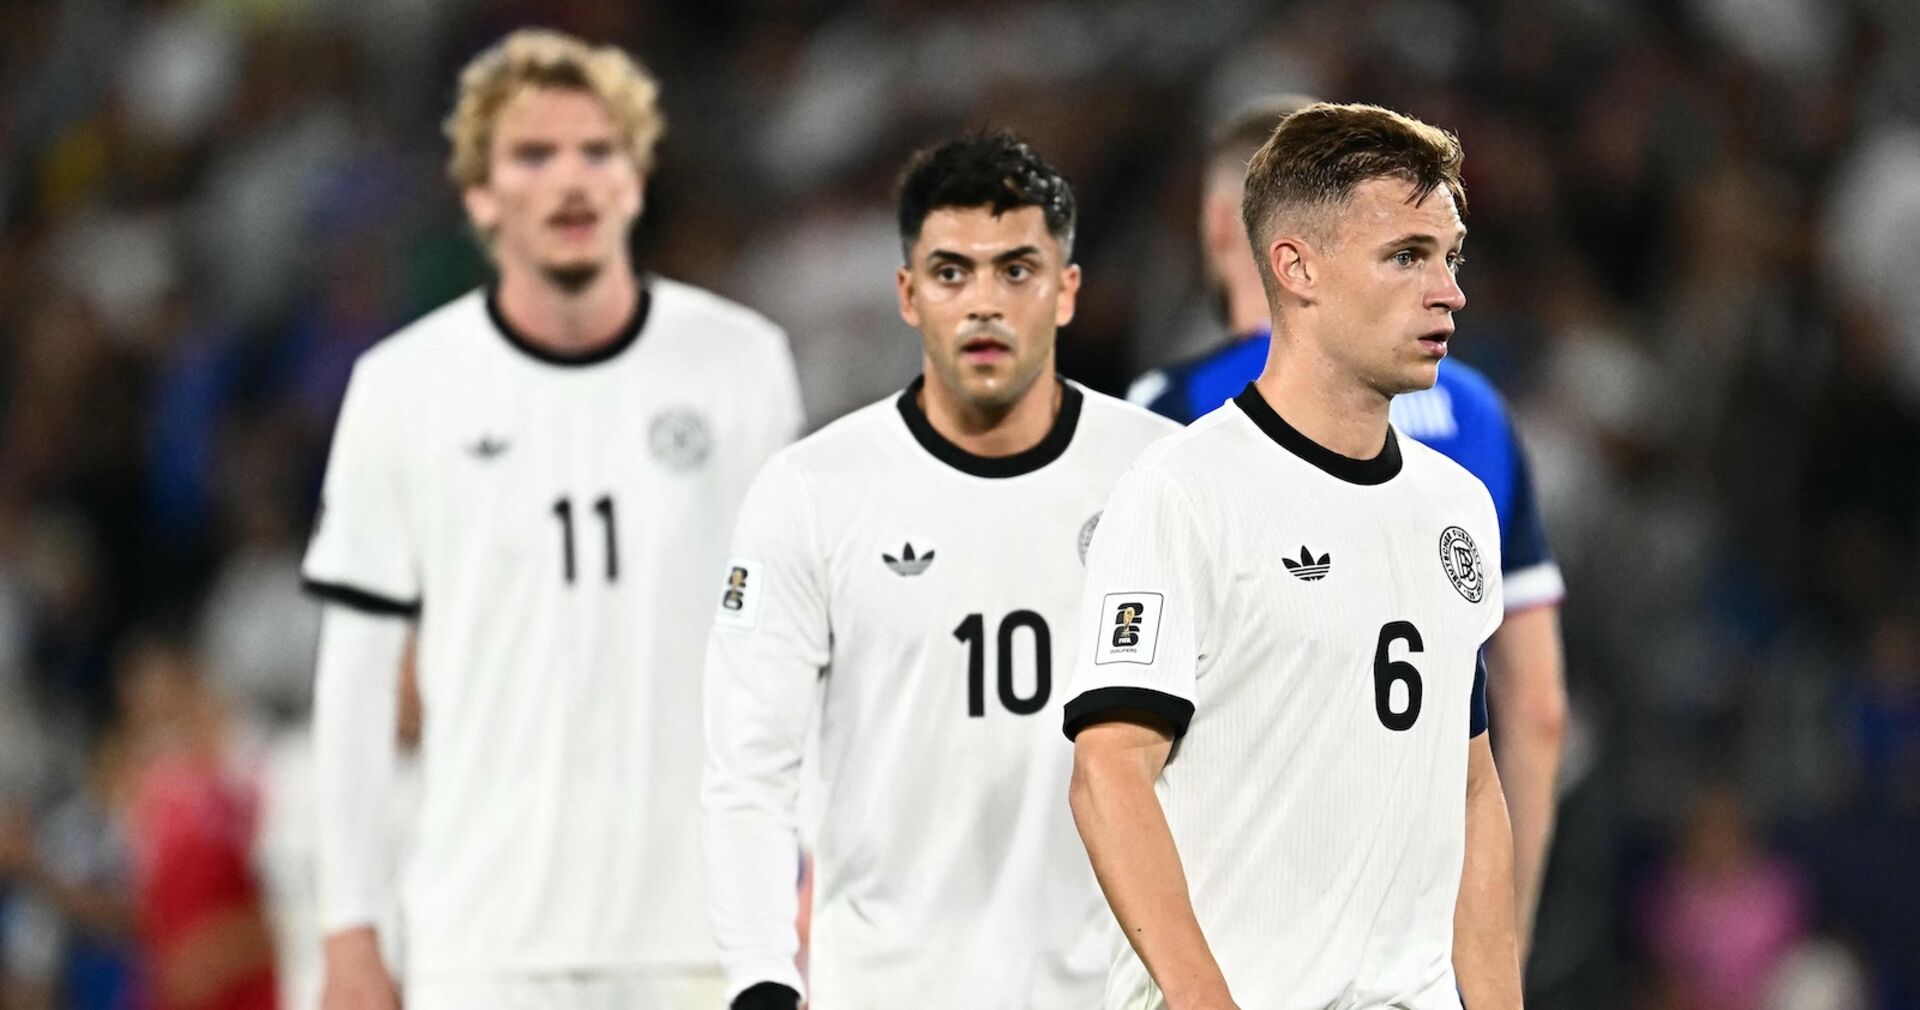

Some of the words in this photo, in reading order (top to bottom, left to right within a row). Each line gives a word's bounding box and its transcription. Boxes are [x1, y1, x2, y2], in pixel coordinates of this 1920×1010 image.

[552, 496, 617, 582] 11
[953, 609, 1051, 717] 10
[1374, 620, 1424, 731] 6
